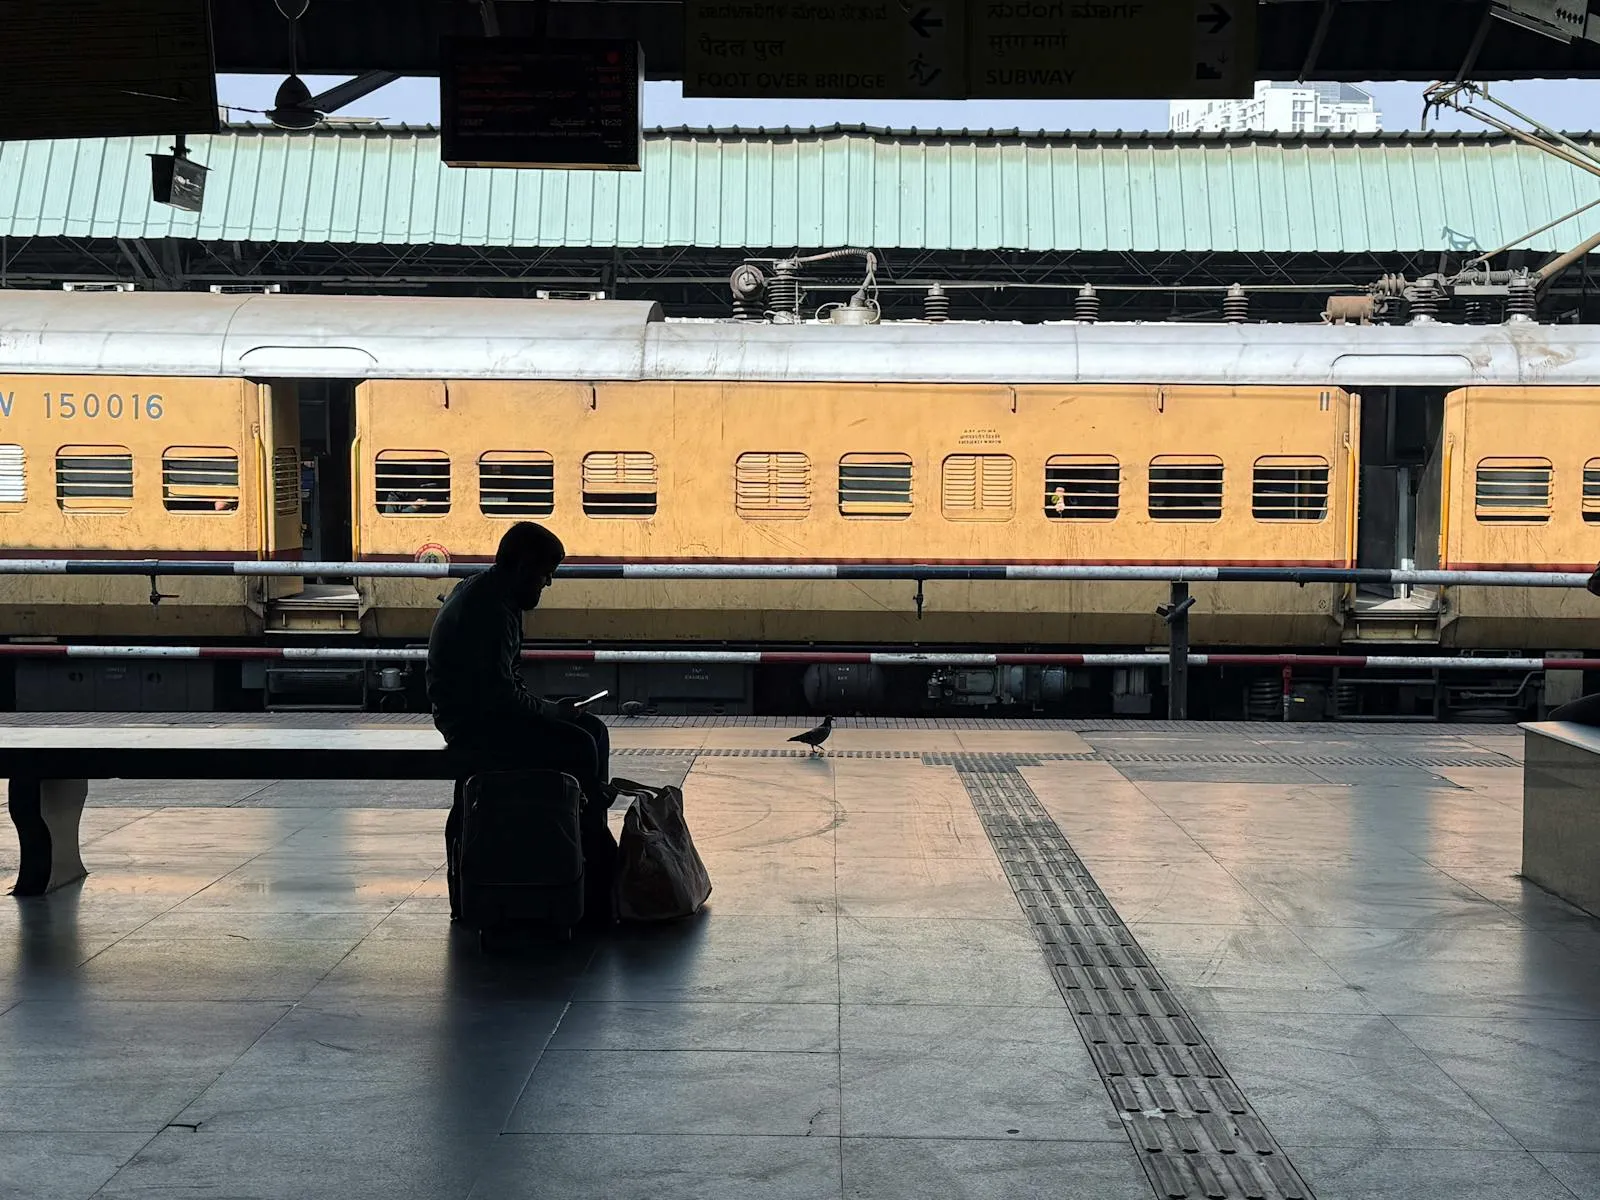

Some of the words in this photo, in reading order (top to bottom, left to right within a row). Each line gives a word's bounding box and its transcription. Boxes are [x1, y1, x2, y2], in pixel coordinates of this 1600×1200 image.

[698, 32, 747, 57] पैदल
[752, 38, 786, 61] पुल
[1032, 29, 1070, 50] मार्ग
[697, 72, 751, 88] FOOT
[756, 72, 809, 88] OVER
[815, 73, 887, 89] BRIDGE
[985, 69, 1076, 86] SUBWAY
[44, 393, 163, 420] 150016
